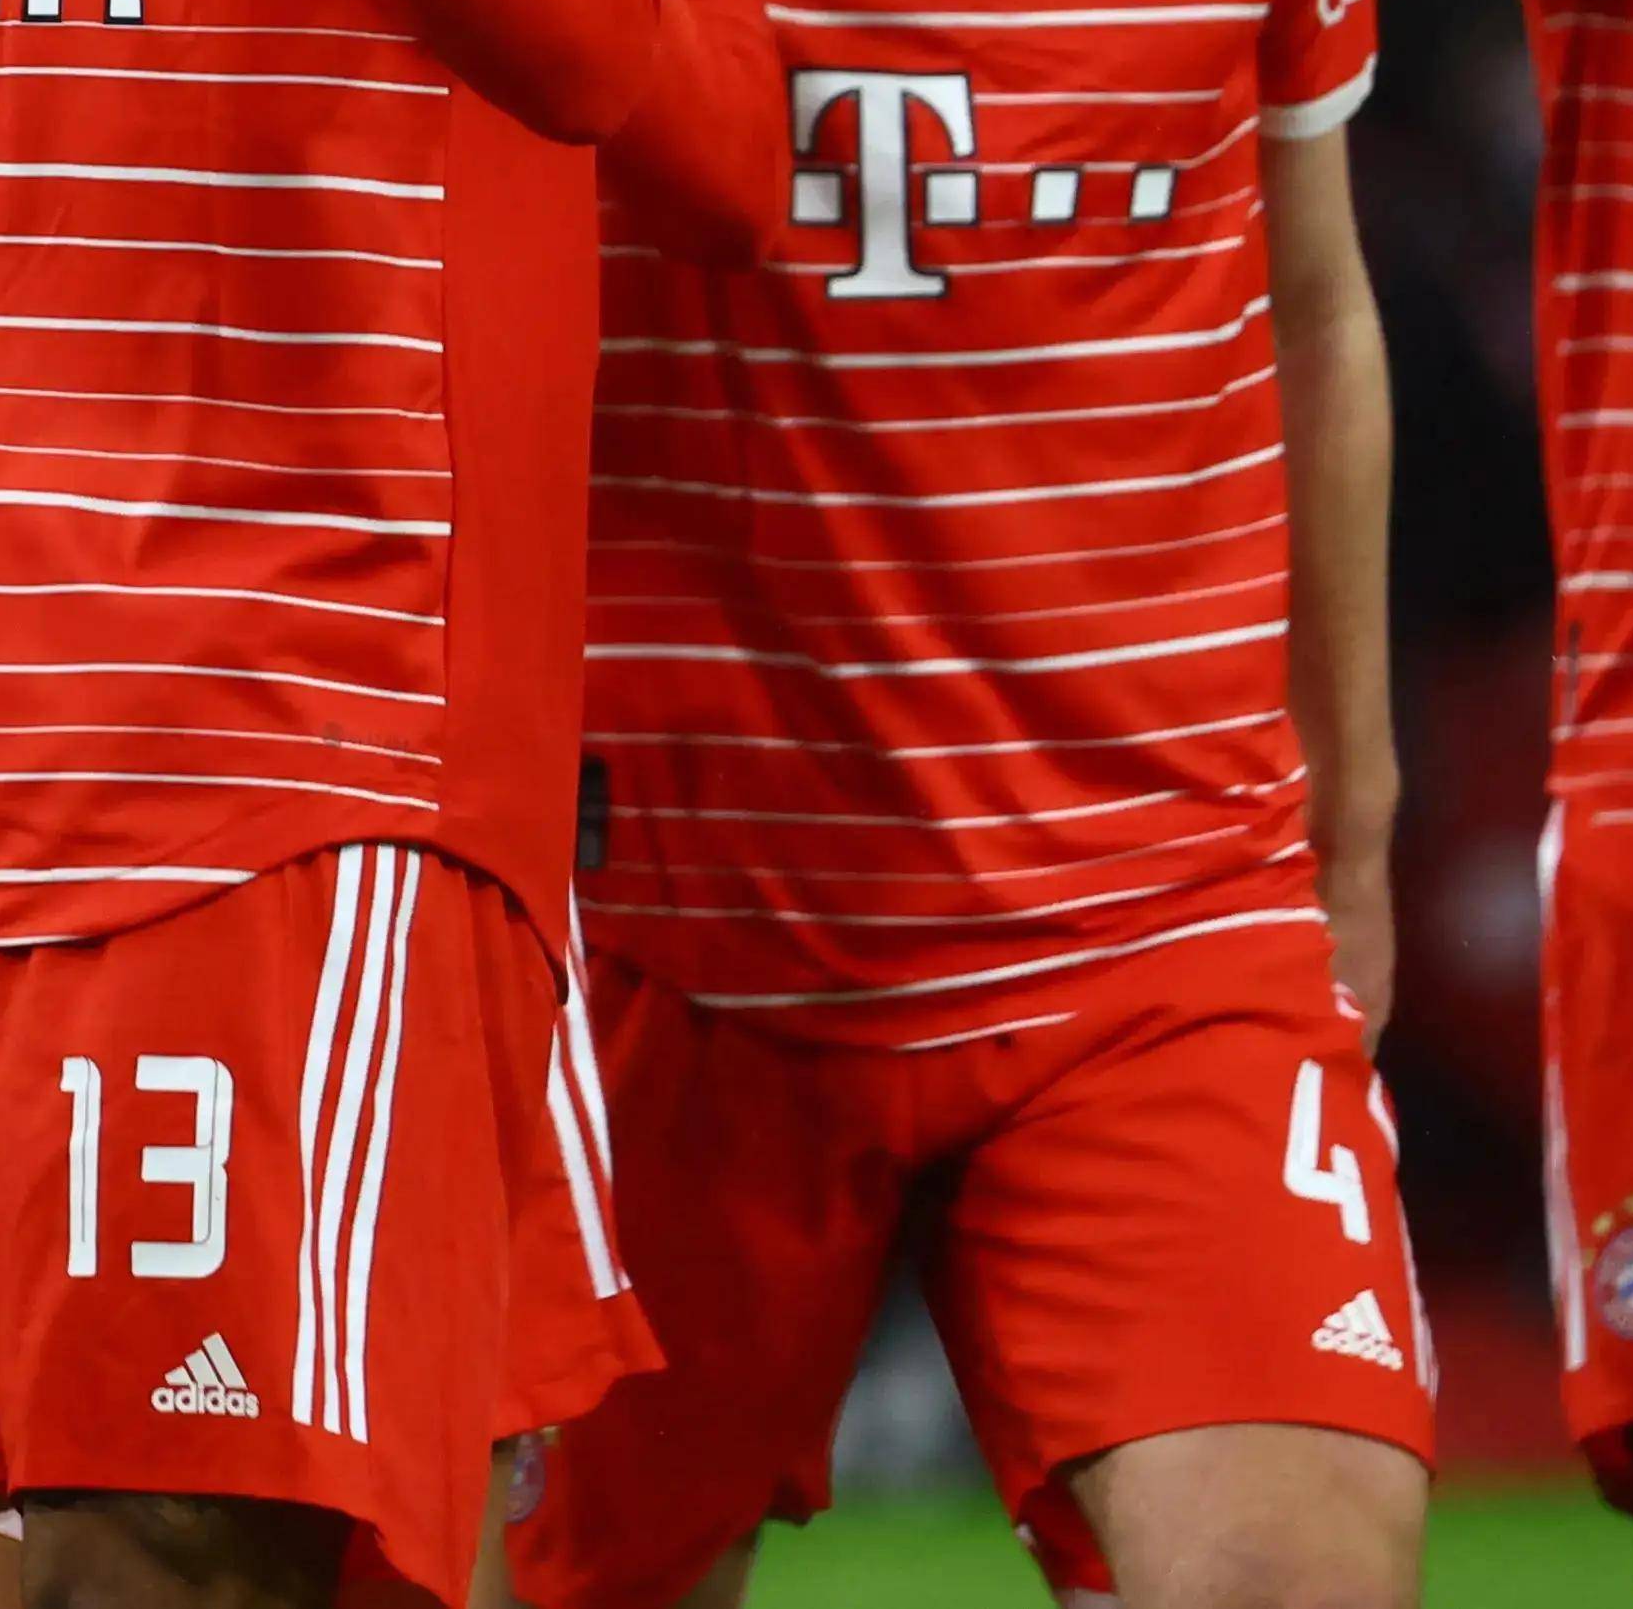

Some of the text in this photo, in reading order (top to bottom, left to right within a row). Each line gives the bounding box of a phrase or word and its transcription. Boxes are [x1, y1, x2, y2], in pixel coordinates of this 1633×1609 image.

[788, 67, 976, 299] T
[59, 1054, 235, 1279] 13
[1283, 1057, 1371, 1245] 4
[151, 1383, 260, 1419] adidas
